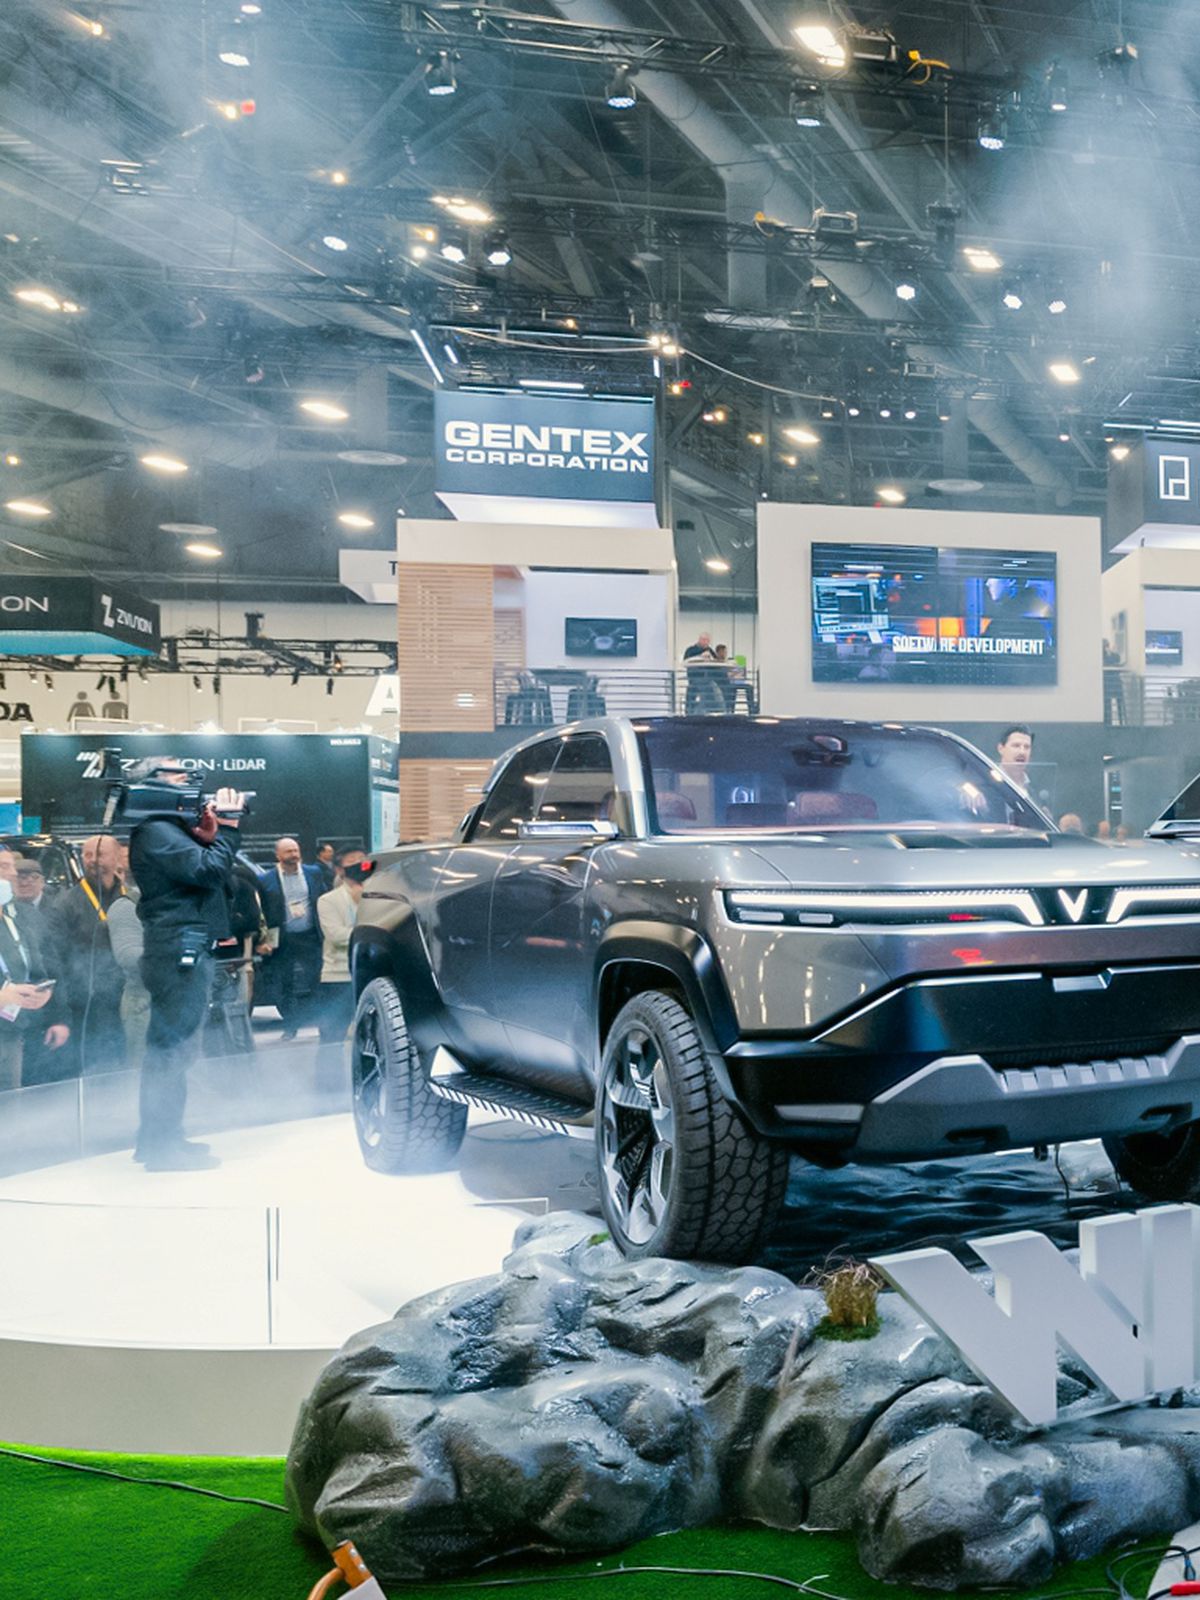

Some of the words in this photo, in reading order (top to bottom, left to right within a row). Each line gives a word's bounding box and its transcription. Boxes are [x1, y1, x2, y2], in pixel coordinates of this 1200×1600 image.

[445, 420, 649, 457] GENTEX
[445, 448, 649, 473] CORPORATION
[958, 638, 1045, 655] DEVELOPMENT
[223, 758, 266, 771] LiDAR
